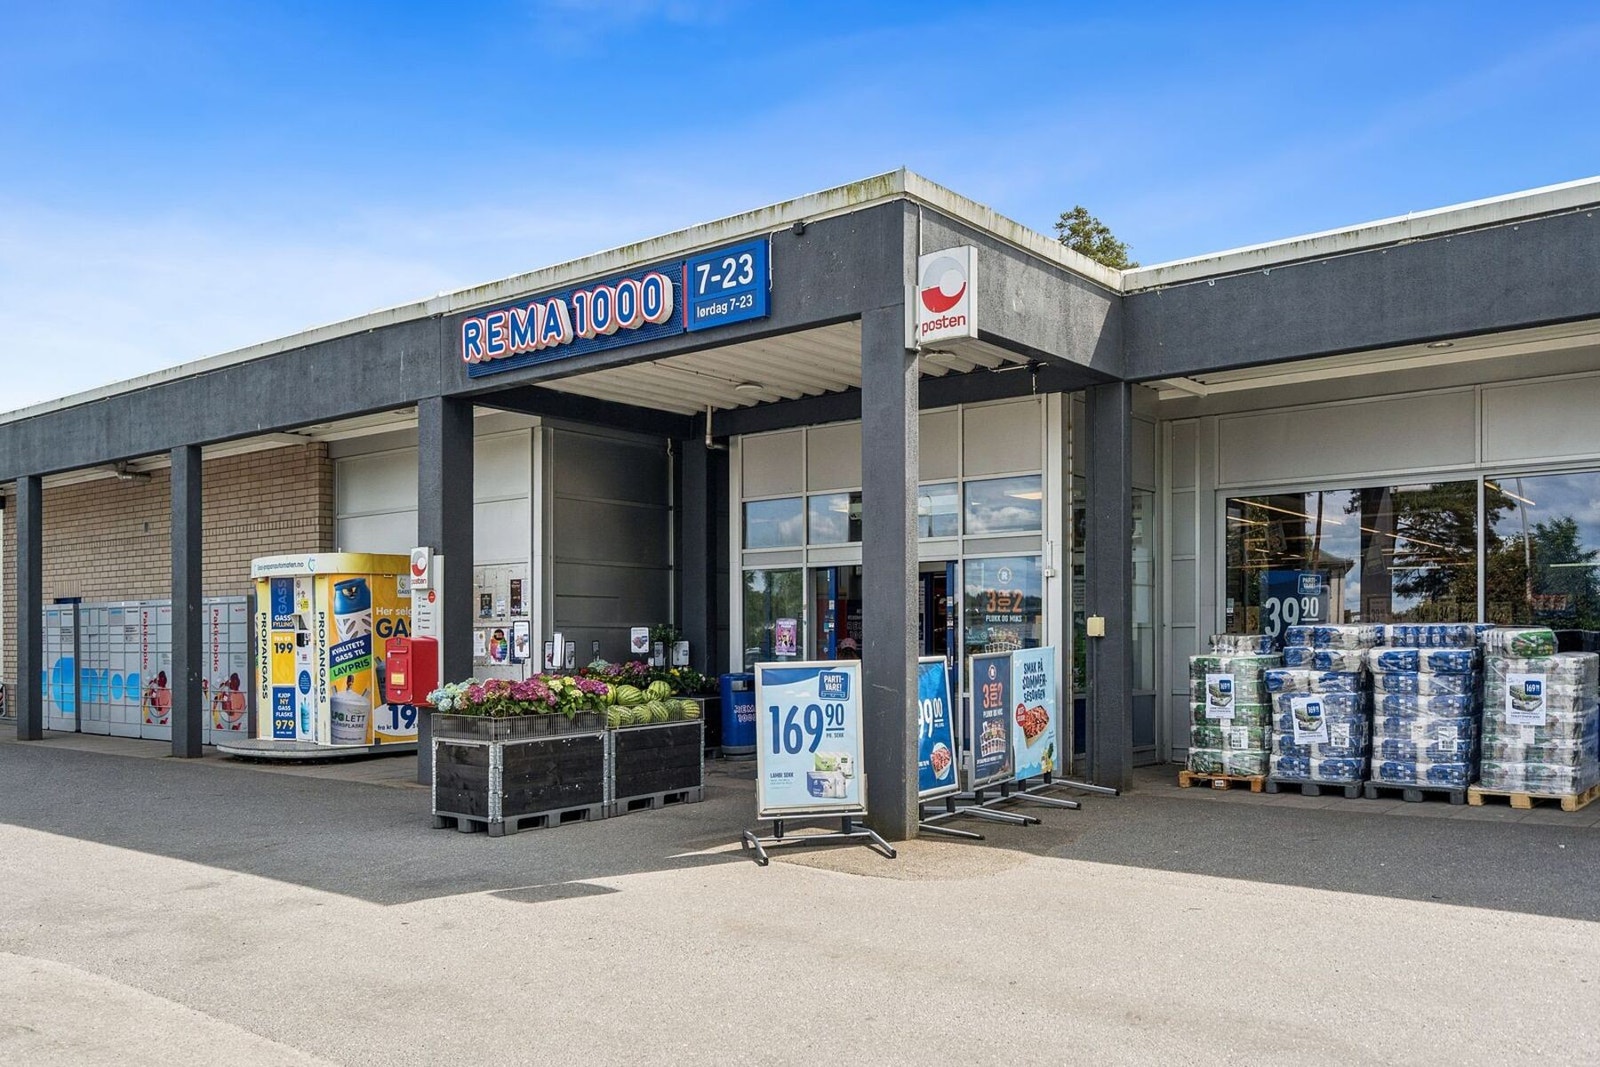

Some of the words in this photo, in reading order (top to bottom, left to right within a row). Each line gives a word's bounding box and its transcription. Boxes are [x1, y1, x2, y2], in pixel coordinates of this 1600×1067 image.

[696, 253, 754, 295] 7-23
[462, 298, 568, 362] REMA
[572, 272, 670, 339] 1000
[696, 301, 728, 318] lørdag
[729, 296, 754, 311] 7-23
[922, 315, 966, 336] posten
[376, 607, 393, 616] Her
[1012, 590, 1023, 613] 2
[1265, 597, 1300, 638] 39
[1301, 597, 1319, 617] 90
[376, 618, 412, 638] GA
[261, 612, 269, 700] PROPANGASS
[274, 642, 294, 654] 199
[318, 611, 327, 704] PROPANGASS
[331, 640, 365, 656] KVALITETS
[335, 652, 353, 662] GASS
[354, 648, 366, 656] TIL
[333, 658, 370, 677] LAVPRIS
[1023, 662, 1037, 674] SMAK
[1038, 658, 1043, 672] PÅ
[823, 675, 844, 684] PARTI-
[825, 683, 842, 692] VARE!
[982, 683, 989, 708] 3
[989, 682, 998, 708] FOR
[275, 720, 294, 730] 979
[345, 714, 365, 722] LETT
[769, 703, 824, 755] 169
[825, 703, 844, 726] 90
